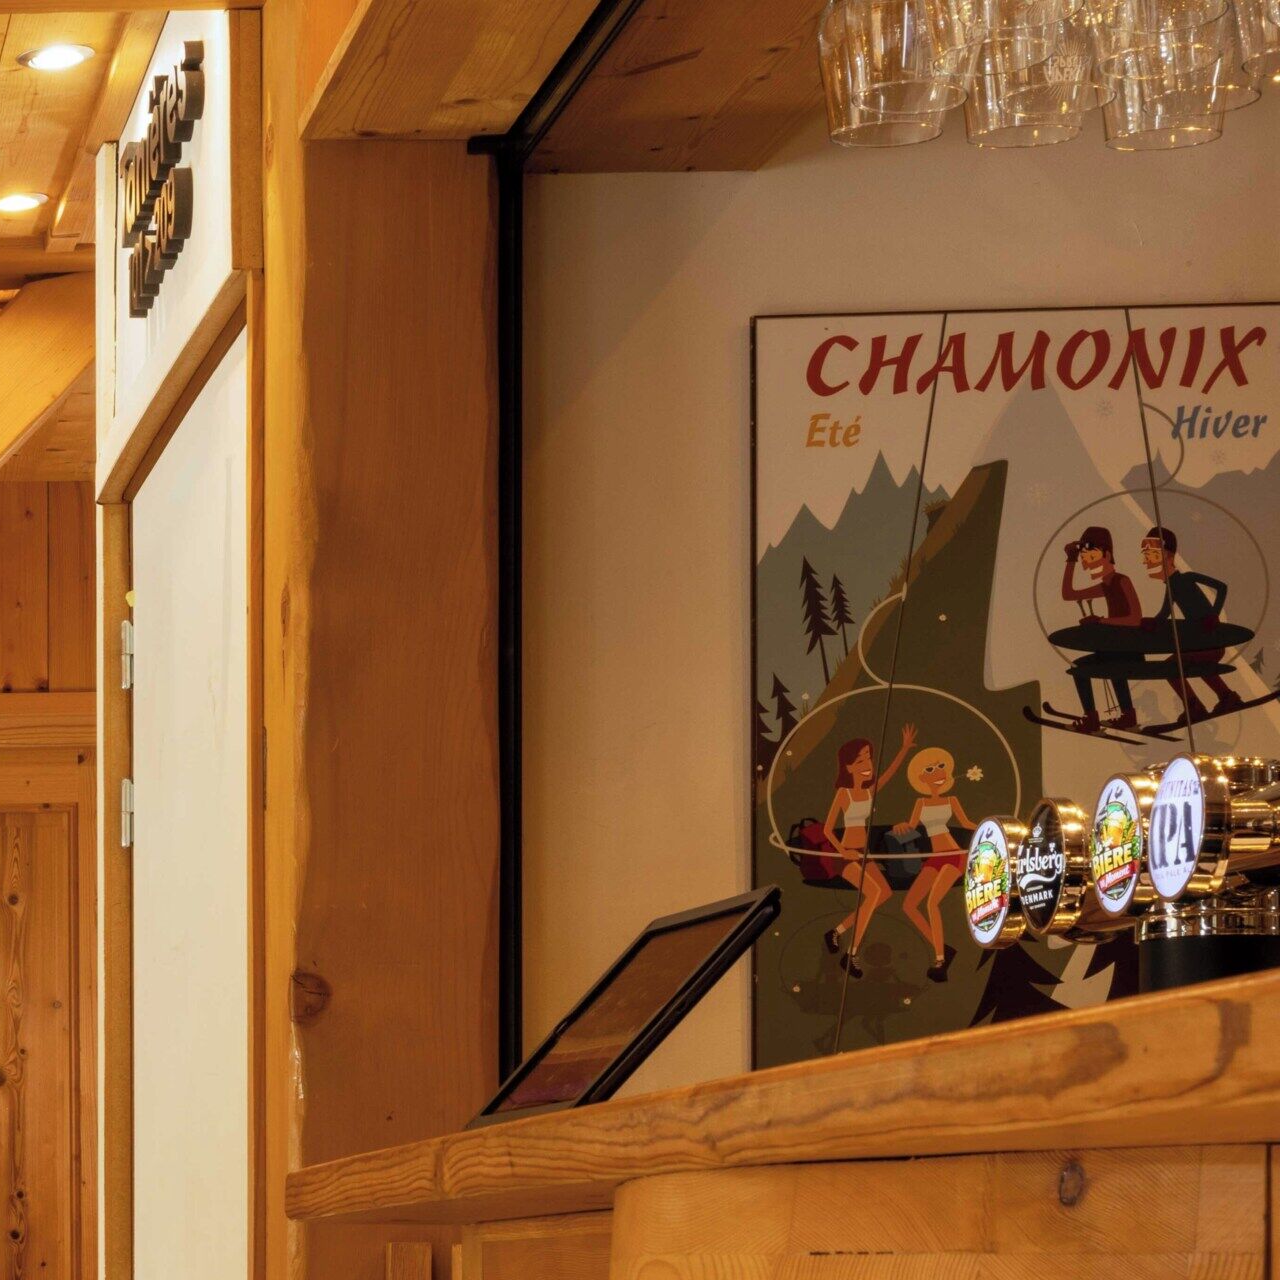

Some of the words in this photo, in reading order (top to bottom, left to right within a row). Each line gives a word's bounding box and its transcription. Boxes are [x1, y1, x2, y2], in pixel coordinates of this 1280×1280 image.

[806, 325, 1267, 397] CHAMONIX
[1170, 403, 1269, 440] Hiver
[1021, 889, 1054, 905] DENMARK
